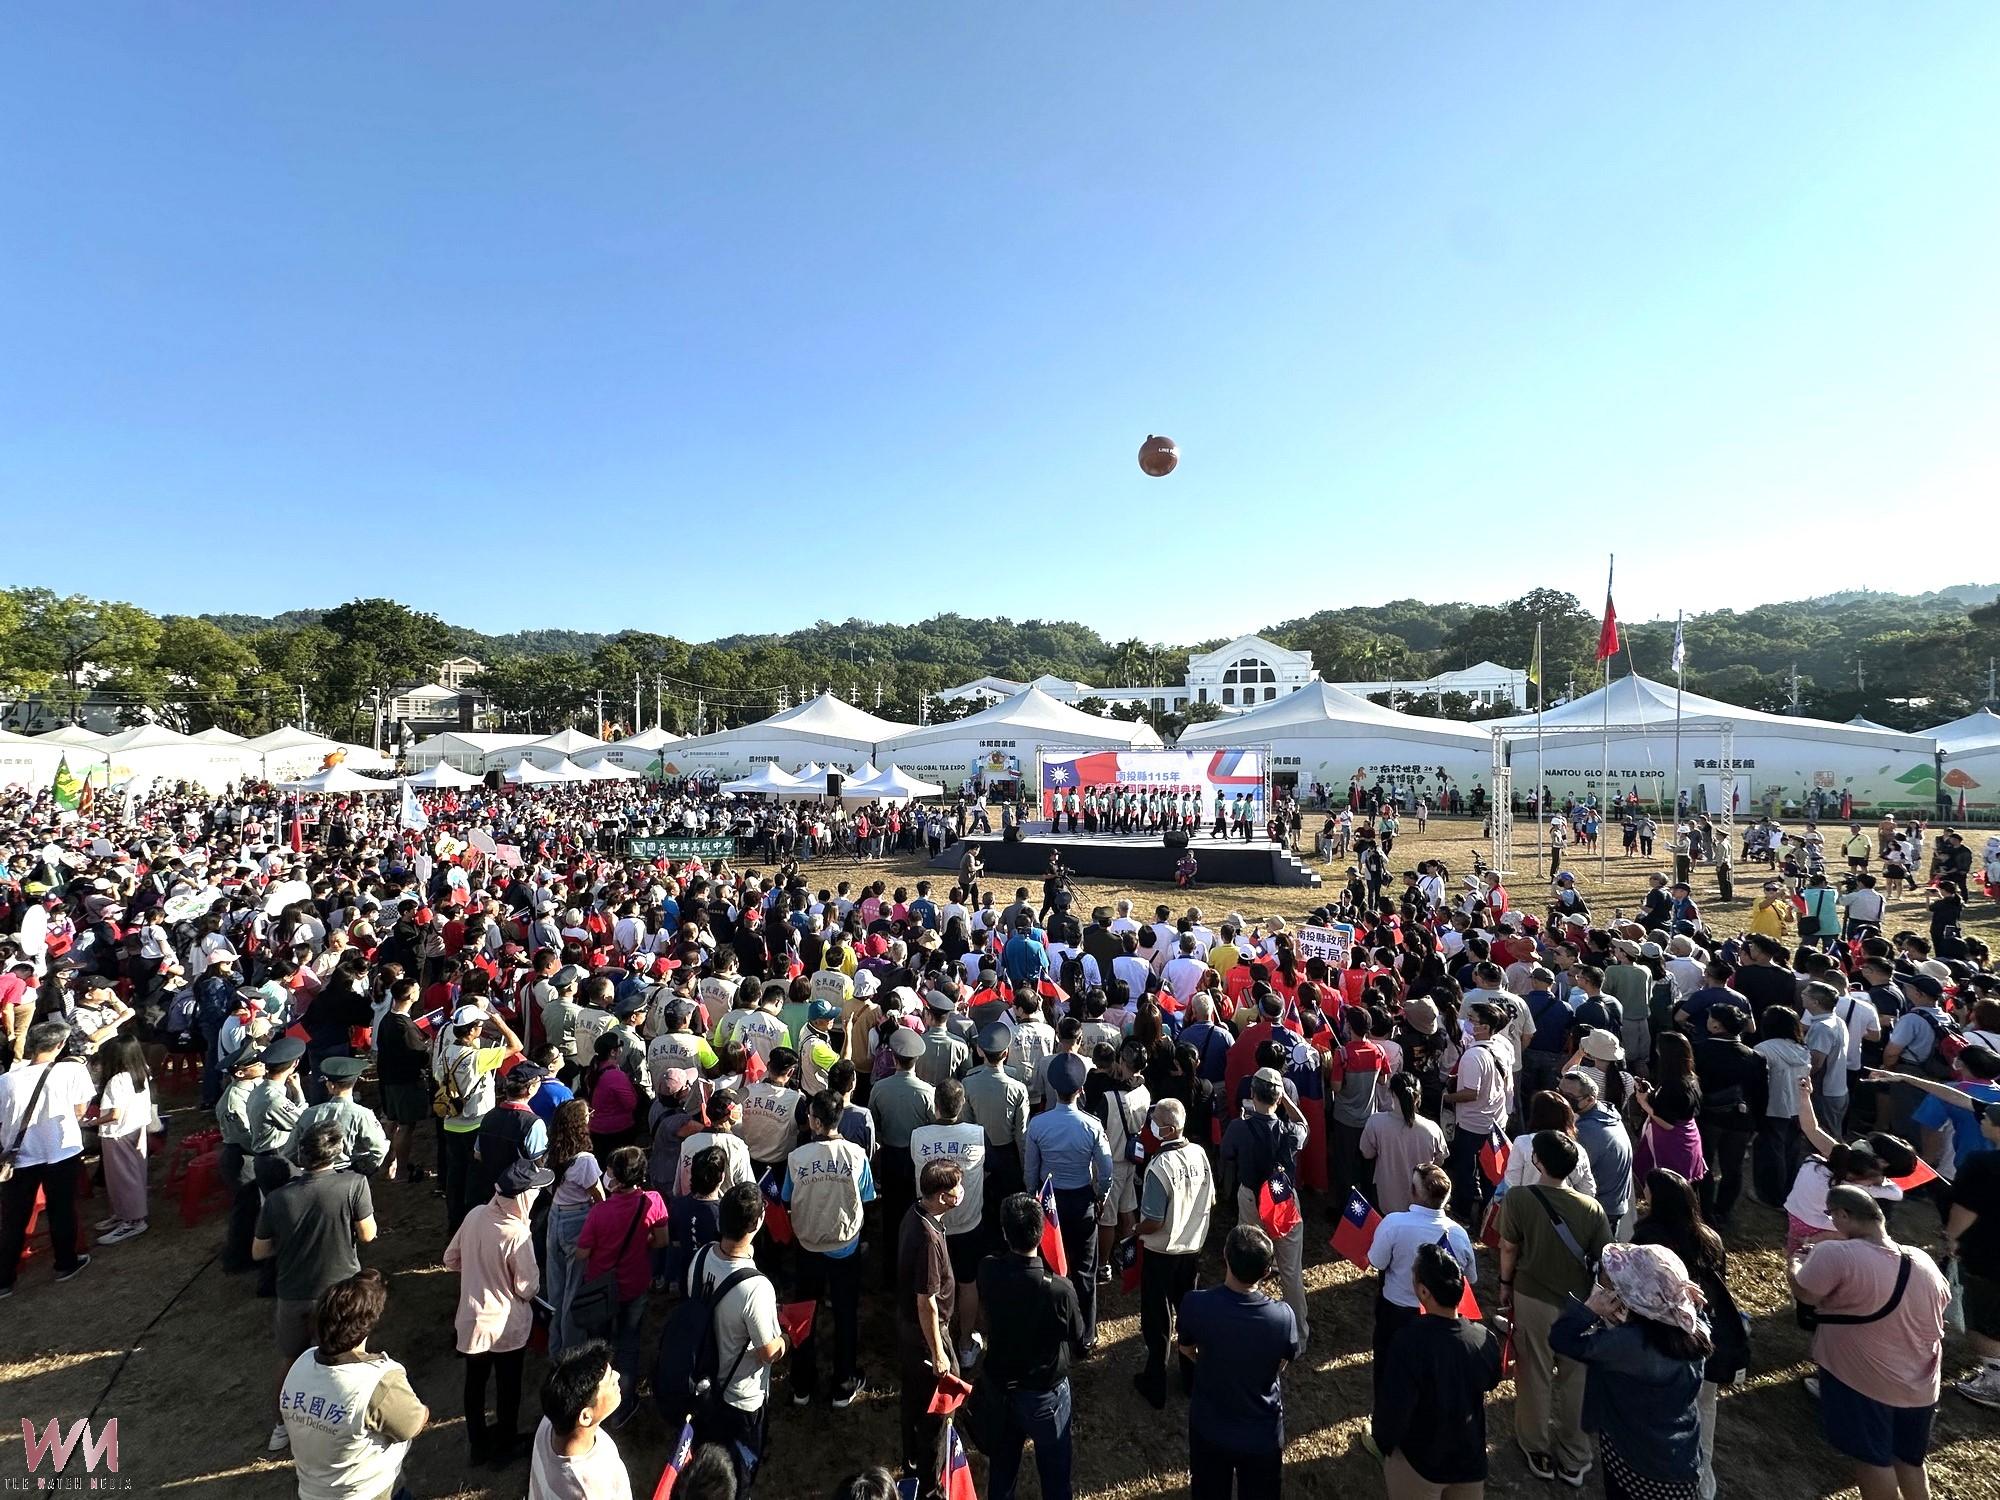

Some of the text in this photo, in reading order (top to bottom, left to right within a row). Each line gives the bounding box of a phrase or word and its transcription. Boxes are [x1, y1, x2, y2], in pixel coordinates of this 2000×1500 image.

[1380, 764, 1421, 774] 南投世界
[1544, 769, 1665, 778] NANTOU GLOAL TEA EXPO
[646, 841, 733, 852] 國立中興高級中學
[1297, 930, 1348, 949] 南投縣政府
[1301, 943, 1341, 961] 衛生局
[744, 1096, 788, 1116] 全民國防
[920, 1141, 974, 1157] 全民國防
[797, 1159, 853, 1180] 全民國防
[280, 1389, 347, 1425] 全民國防
[306, 1416, 339, 1436] Defense
